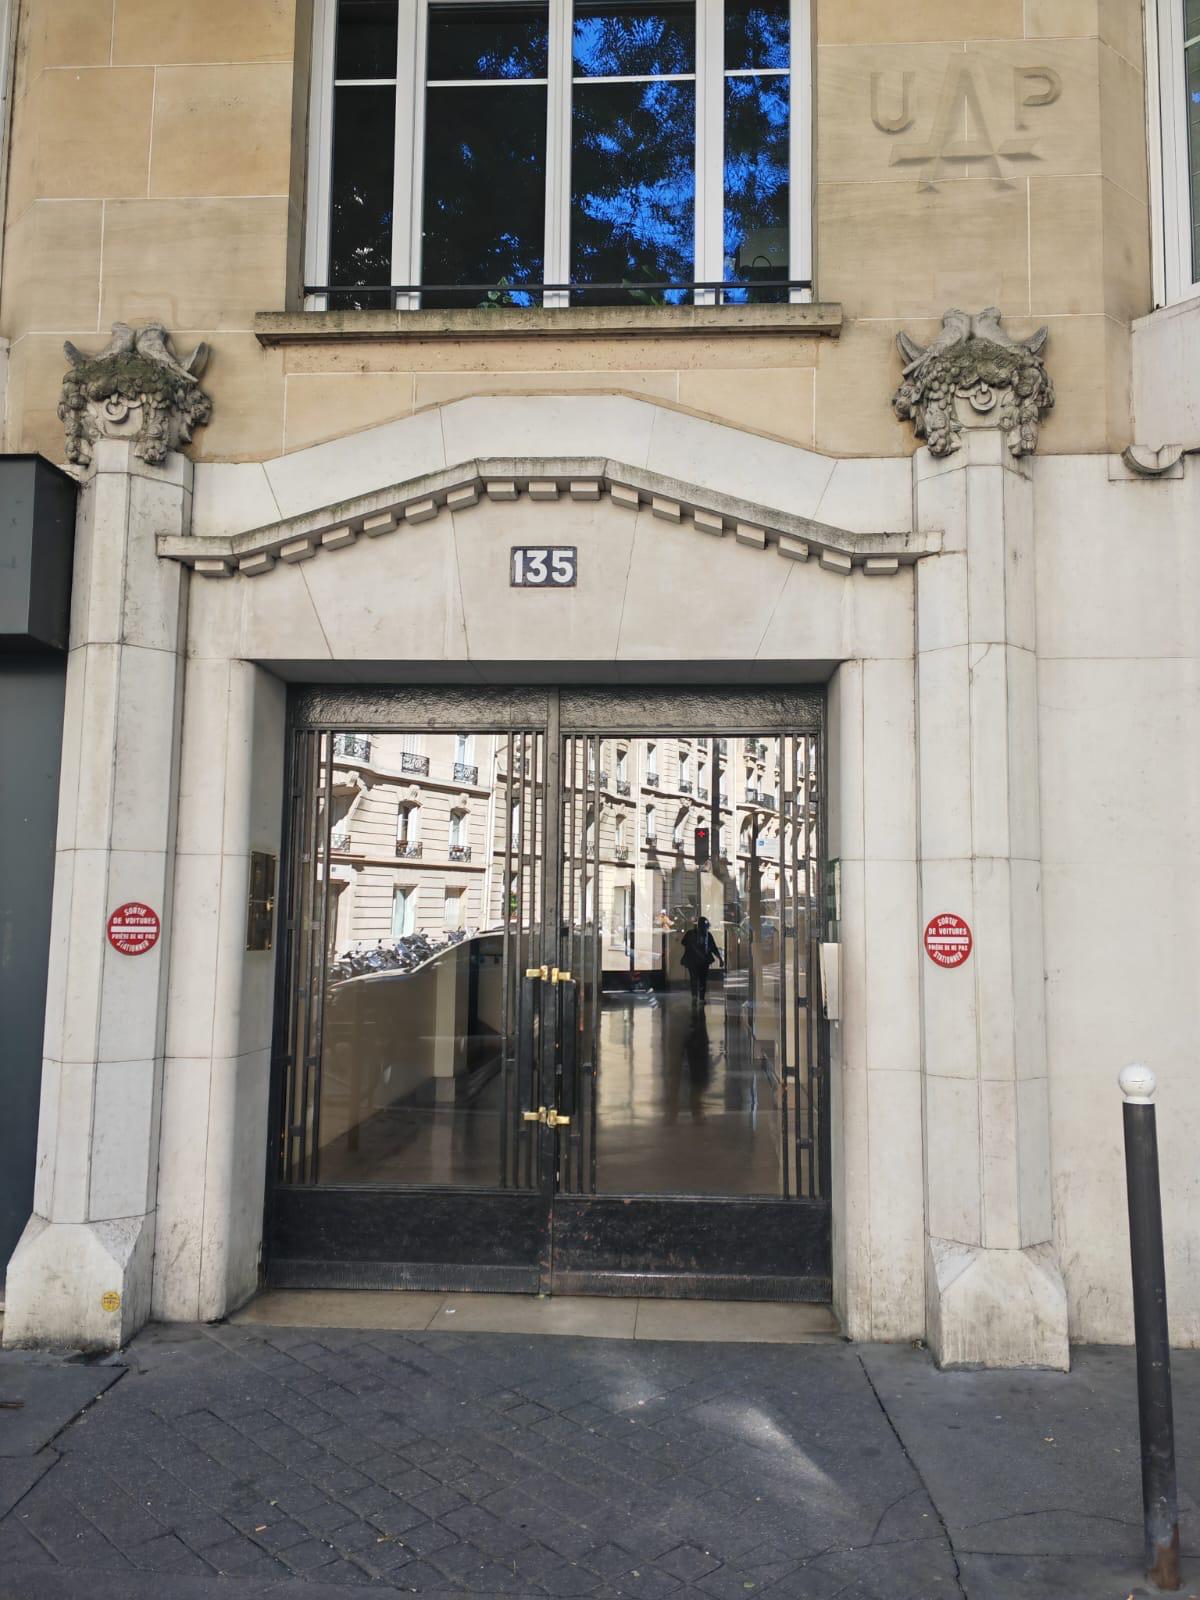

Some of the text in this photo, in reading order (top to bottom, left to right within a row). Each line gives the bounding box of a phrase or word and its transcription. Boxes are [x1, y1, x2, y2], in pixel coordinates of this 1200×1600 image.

[871, 53, 1062, 194] UAP
[513, 550, 574, 583] 135
[112, 917, 156, 925] DE VOITURES
[937, 916, 958, 927] SORTIE
[928, 927, 968, 935] DE VOITURES
